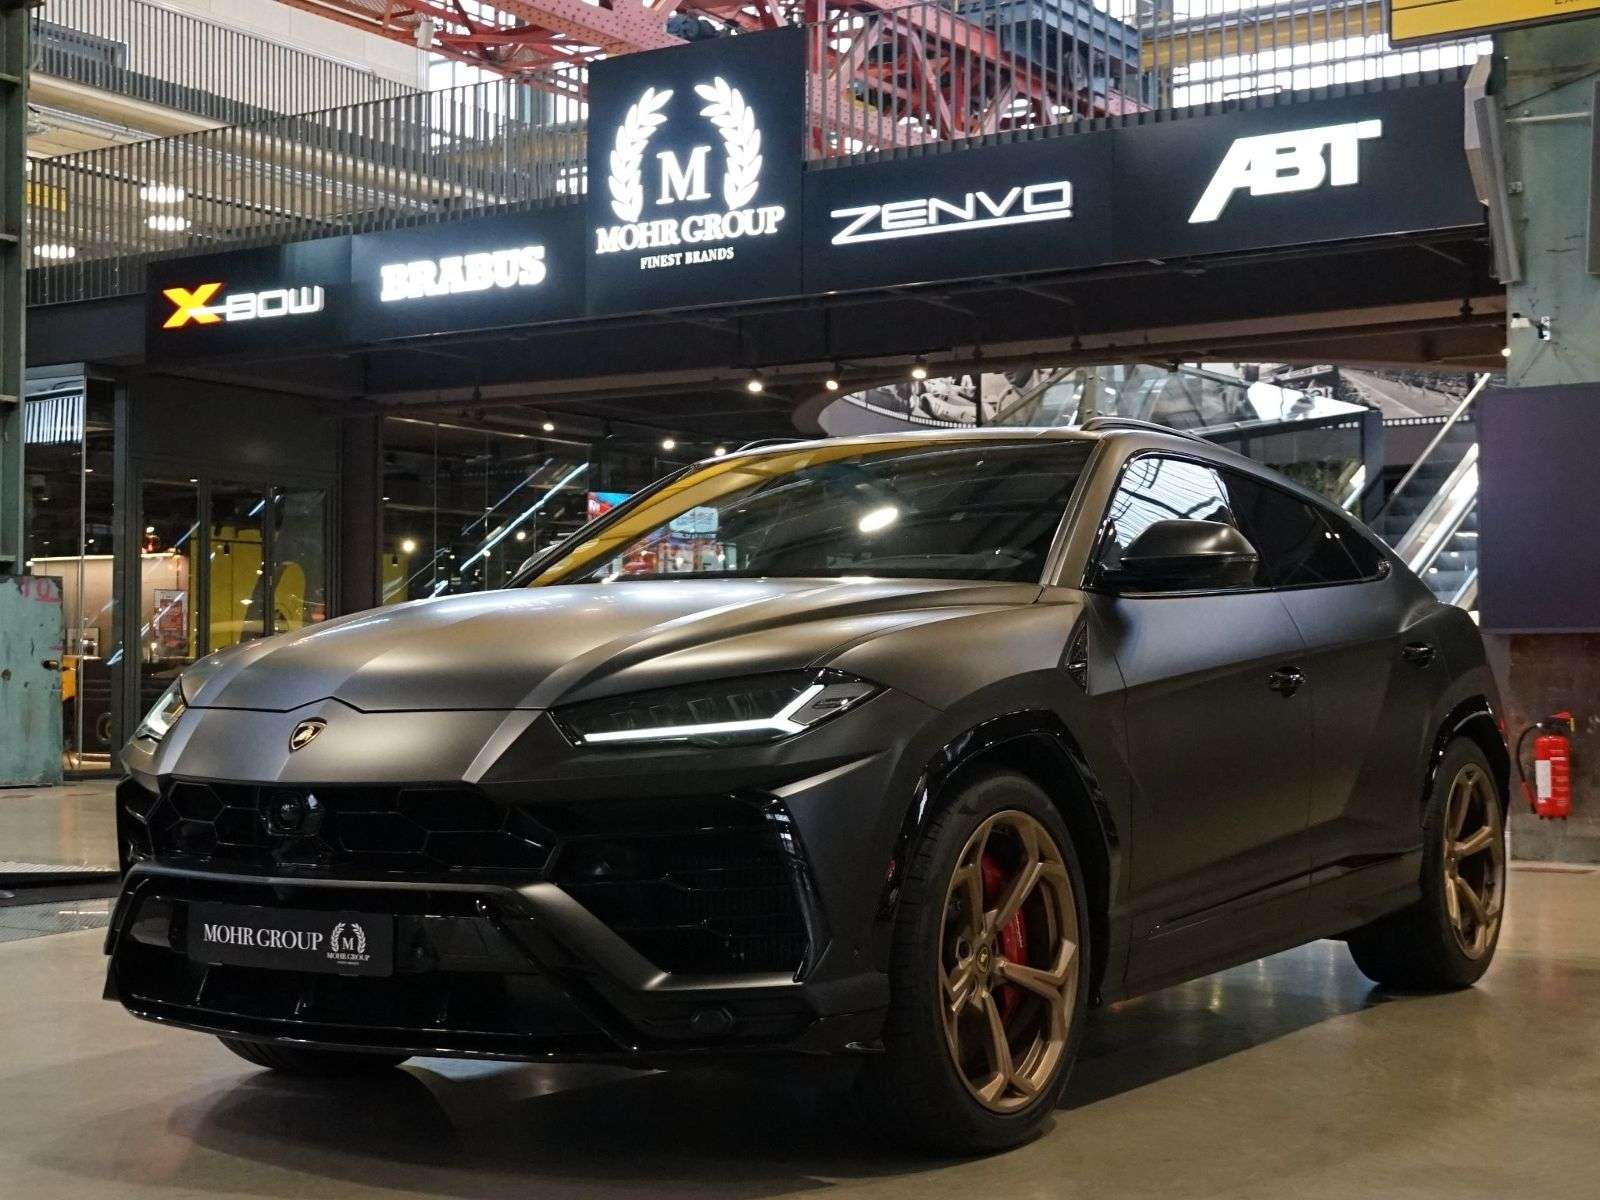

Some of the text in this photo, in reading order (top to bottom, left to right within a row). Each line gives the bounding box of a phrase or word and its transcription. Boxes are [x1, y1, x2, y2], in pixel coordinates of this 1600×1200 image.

[656, 145, 712, 205] M
[1188, 118, 1382, 224] ABT
[595, 205, 785, 254] MOHR GROUP
[831, 180, 1073, 246] ZENVO
[379, 245, 547, 303] BRABUS
[640, 247, 735, 270] FINEST BRANDS
[162, 281, 325, 329] X-BOW
[203, 923, 323, 950] MOHR GROUP
[342, 937, 354, 950] M
